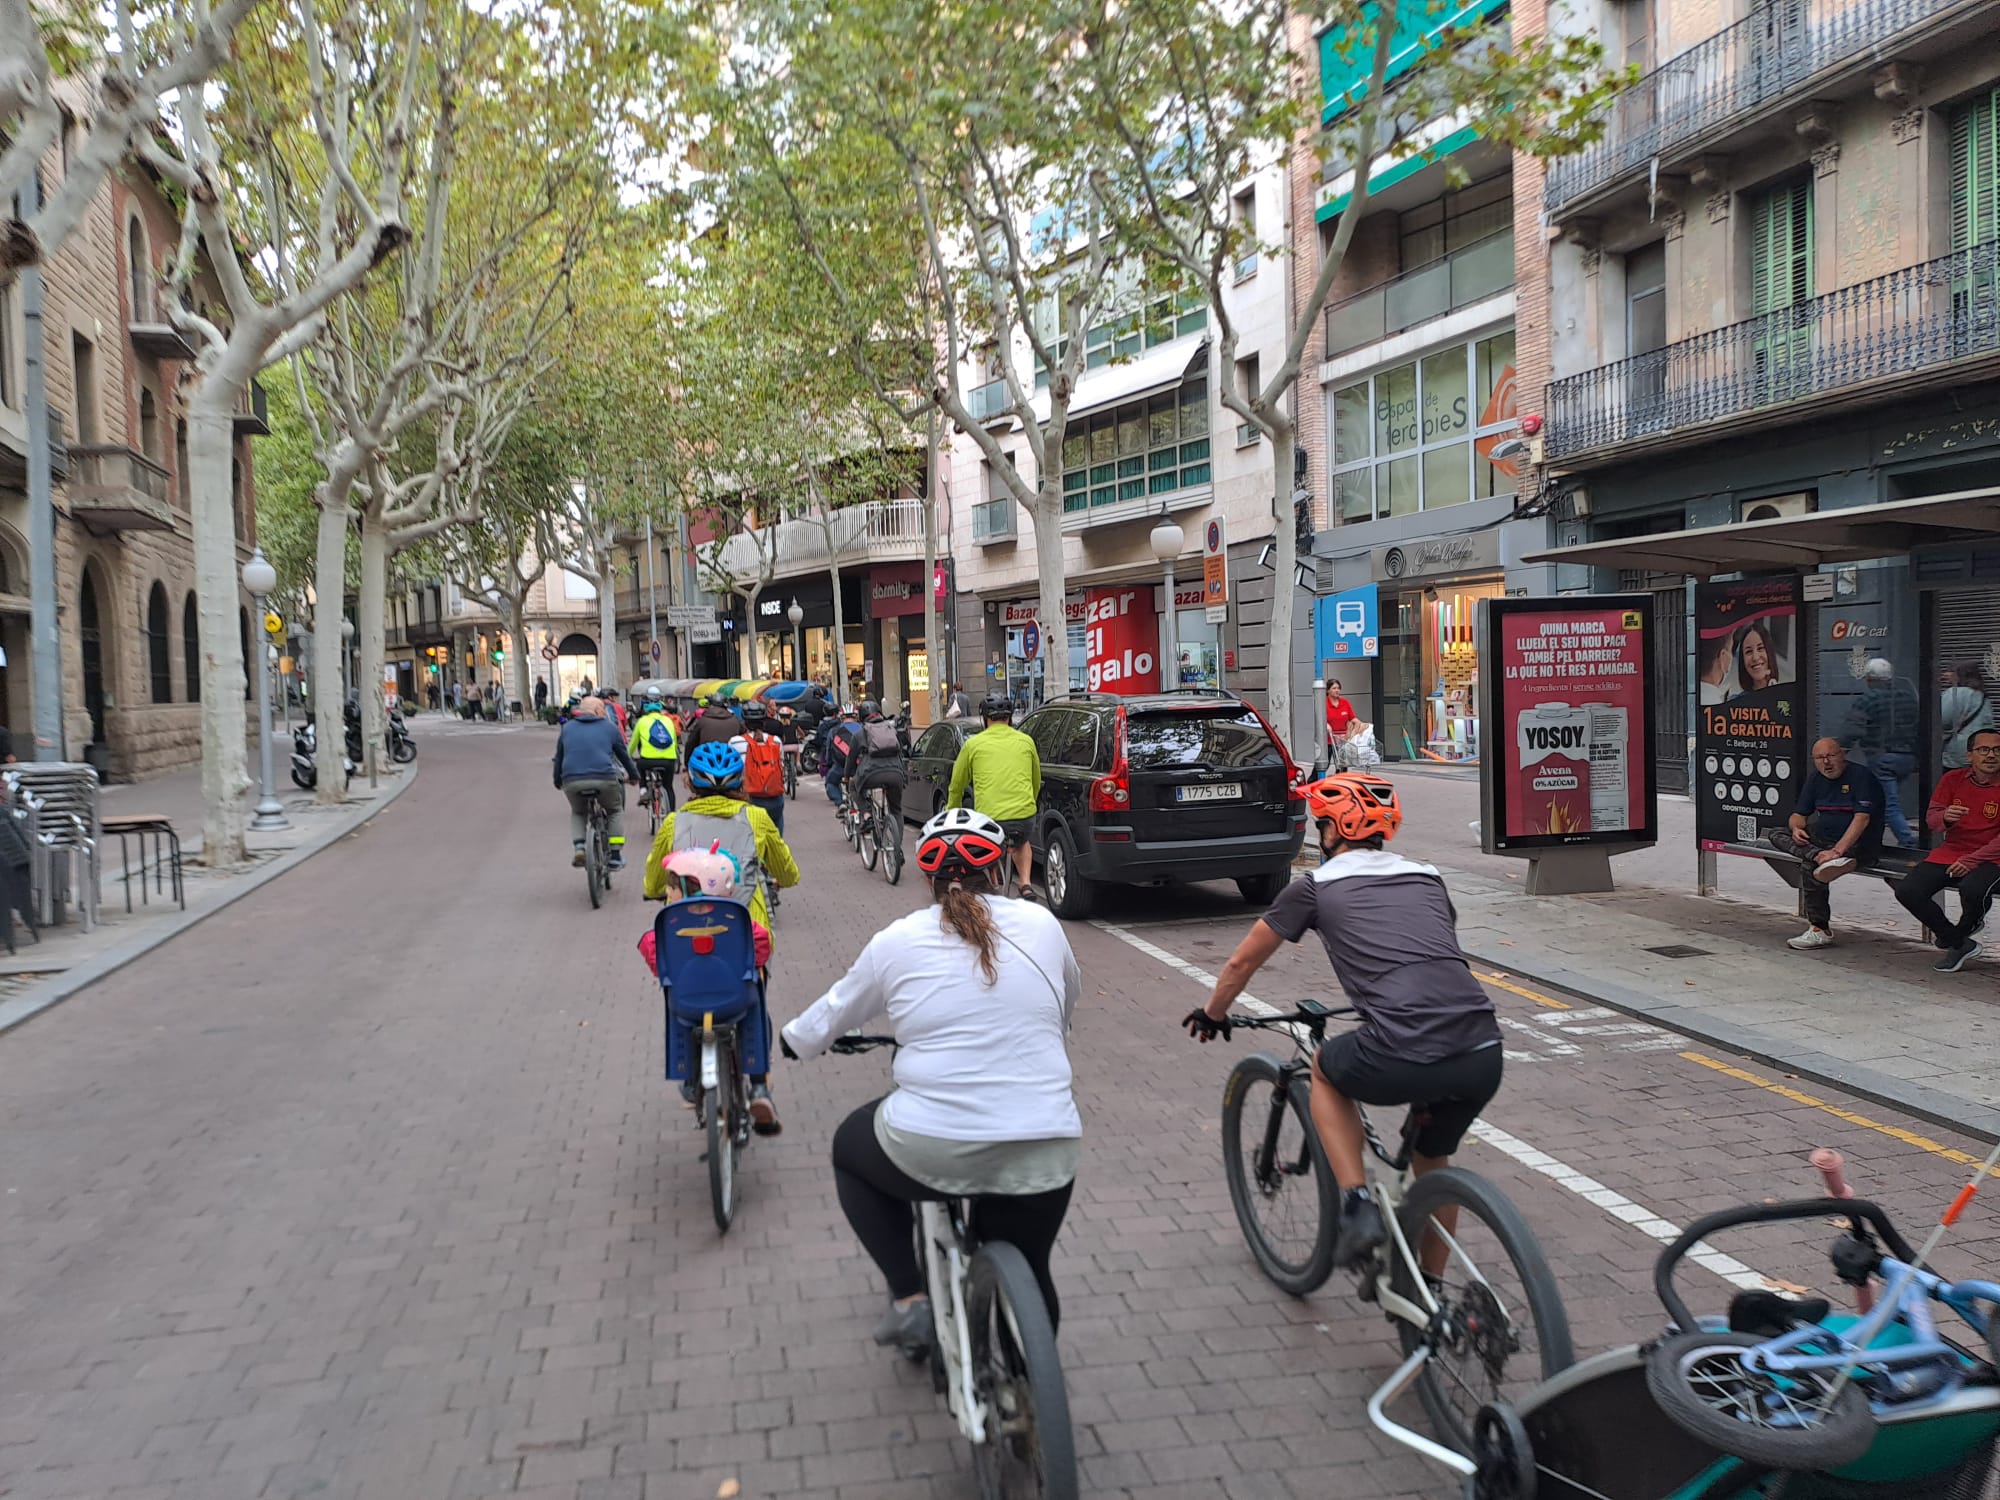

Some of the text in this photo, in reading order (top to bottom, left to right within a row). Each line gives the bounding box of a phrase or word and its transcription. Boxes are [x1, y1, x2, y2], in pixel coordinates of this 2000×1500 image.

[1425, 392, 1438, 408] de
[1006, 606, 1038, 620] Bazar
[1087, 592, 1135, 624] zar
[1540, 622, 1606, 637] QUINA MARCA
[1517, 635, 1626, 650] LLUEIX EL SEU NOU PACK
[1523, 649, 1621, 664] TAMBÉ PEL DARRERE?
[1506, 663, 1637, 679] LA QUE NO TÉ RES A AMAGAR.
[1528, 683, 1568, 693] ingredients
[1573, 683, 1594, 692] sense
[1703, 706, 1727, 737] 1a
[1729, 707, 1770, 721] VISITA
[1525, 726, 1584, 749] YOSOY
[1729, 722, 1792, 739] GRATUÏTA
[1539, 766, 1572, 776] Avena
[1547, 778, 1576, 787] AZÚCAR
[1187, 784, 1237, 799] 1775 CZB
[1721, 804, 1773, 816] ODONTOCLINIC.ES
